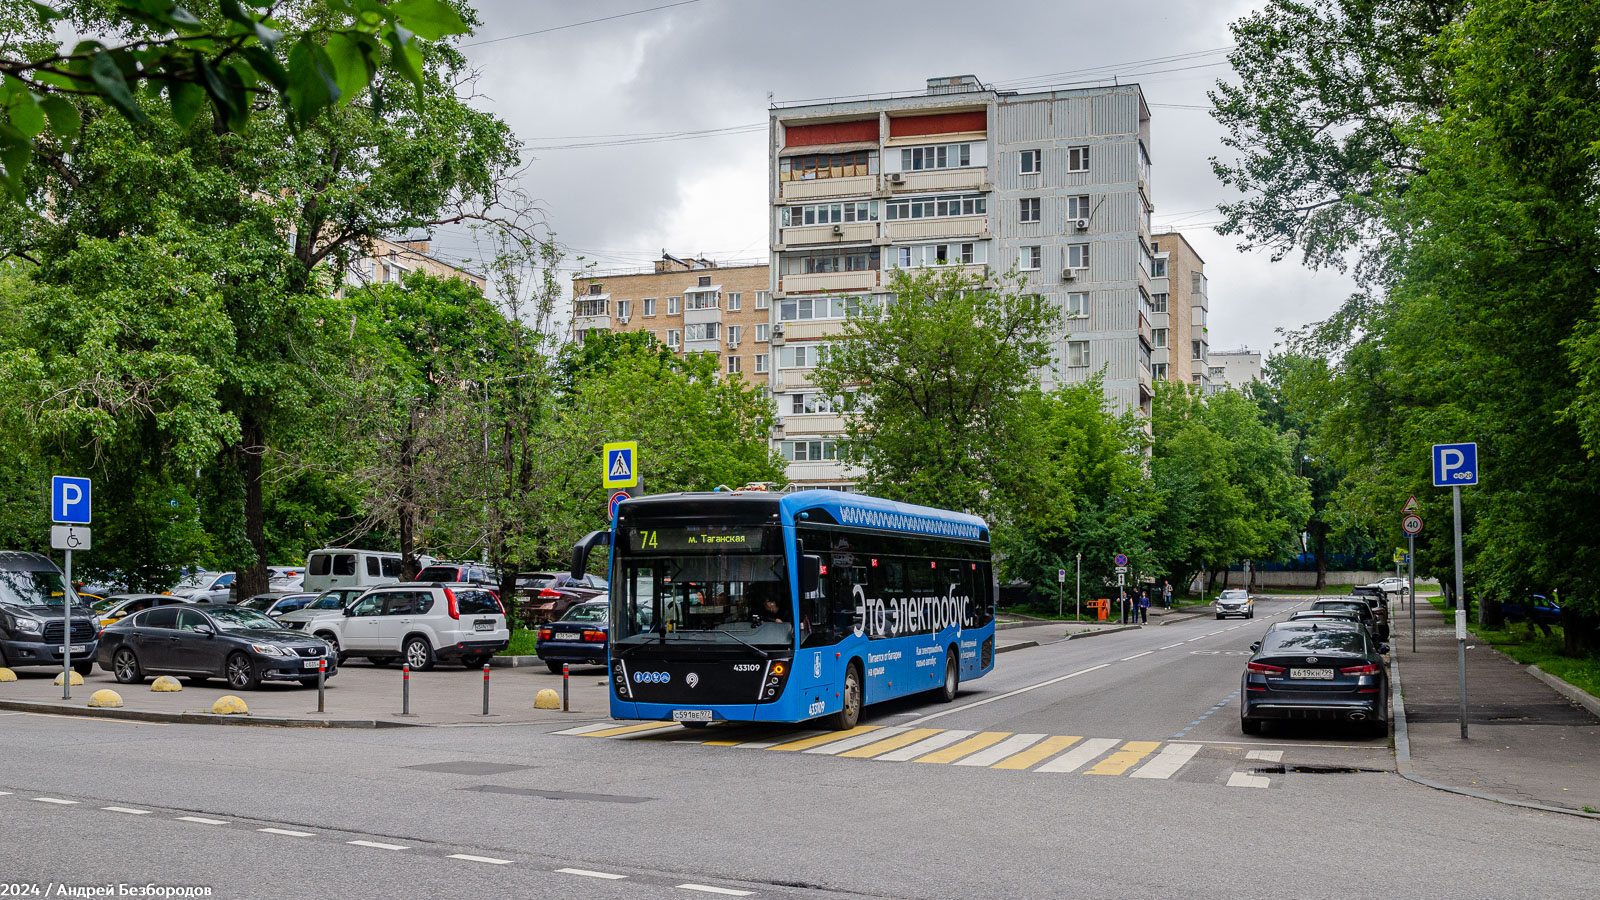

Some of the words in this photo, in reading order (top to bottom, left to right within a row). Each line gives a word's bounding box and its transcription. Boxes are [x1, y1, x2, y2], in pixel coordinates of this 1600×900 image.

[1441, 449, 1464, 481] P
[62, 483, 82, 517] P
[1406, 520, 1419, 529] 40
[640, 530, 658, 549] 74
[701, 534, 746, 544] Таганская
[852, 584, 886, 638] Это
[890, 583, 973, 641] электробус.
[733, 664, 760, 672] 433109
[808, 701, 825, 716] 433109
